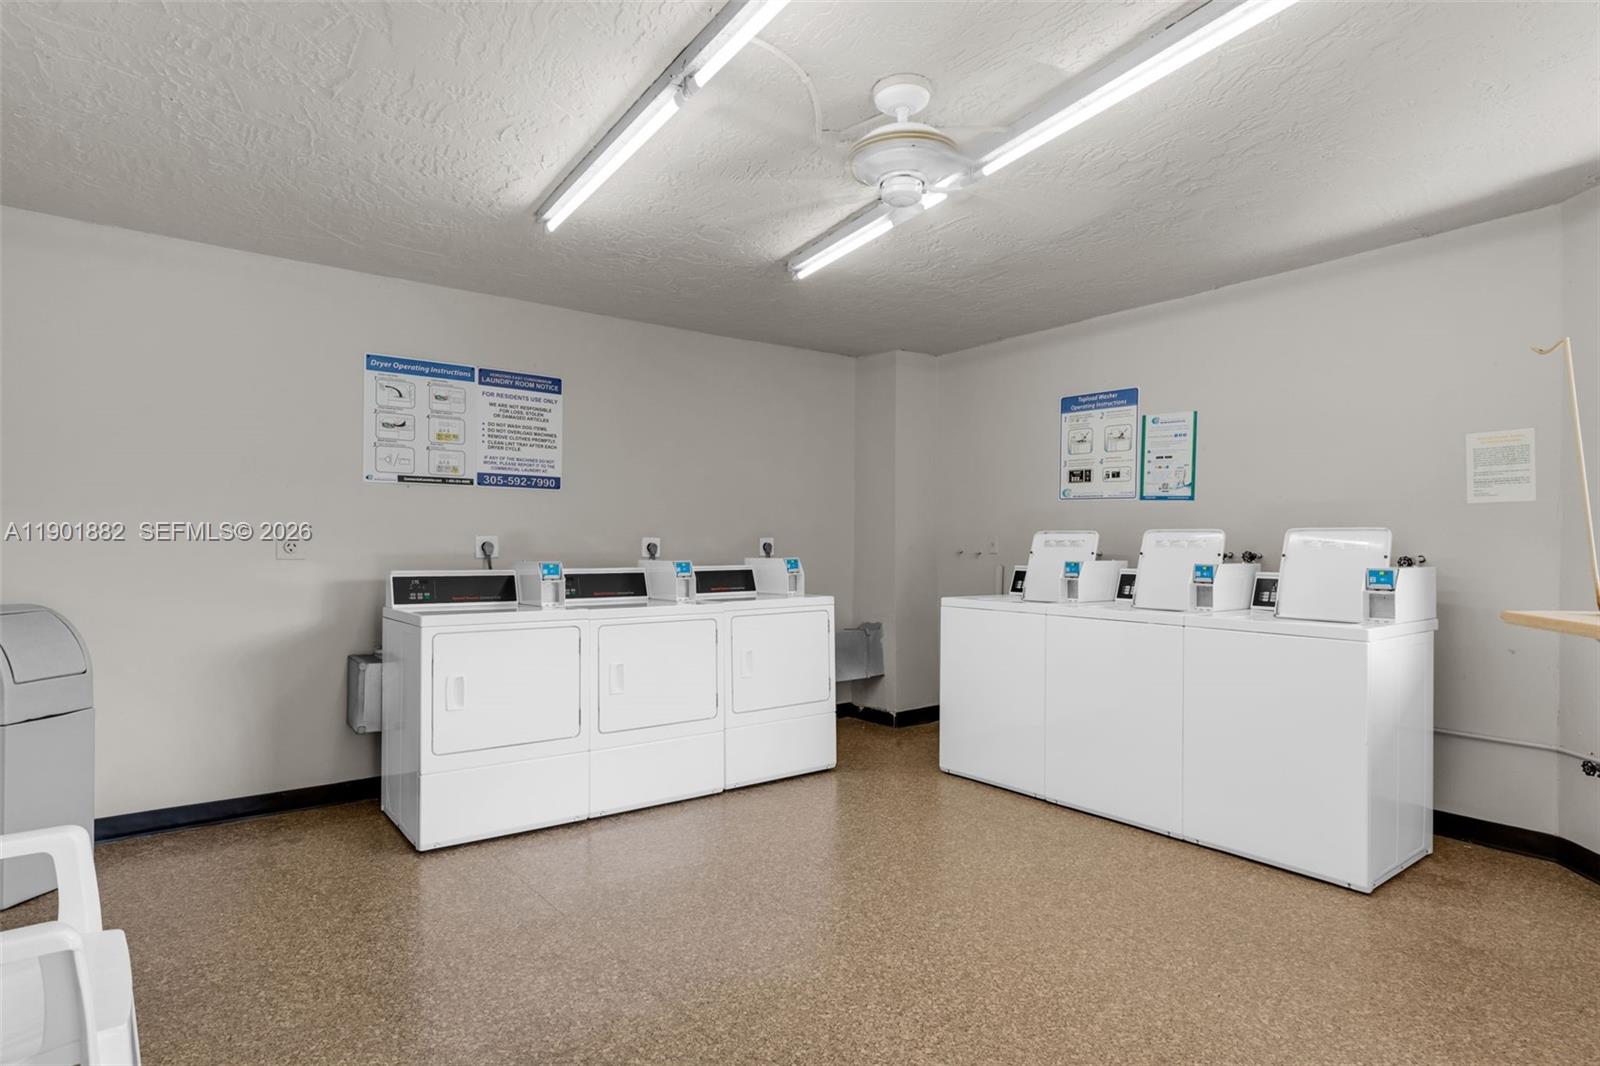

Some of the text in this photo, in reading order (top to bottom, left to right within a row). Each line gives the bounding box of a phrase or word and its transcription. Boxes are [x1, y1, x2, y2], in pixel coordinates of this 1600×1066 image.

[370, 359, 471, 377] Dryer Operating Instructions
[481, 376, 513, 385] LAUNDRY
[536, 383, 559, 392] NOTICE
[496, 392, 529, 401] RESIDENTS
[1070, 400, 1127, 411] Operating Instructions
[483, 475, 555, 488] 305-592-7990
